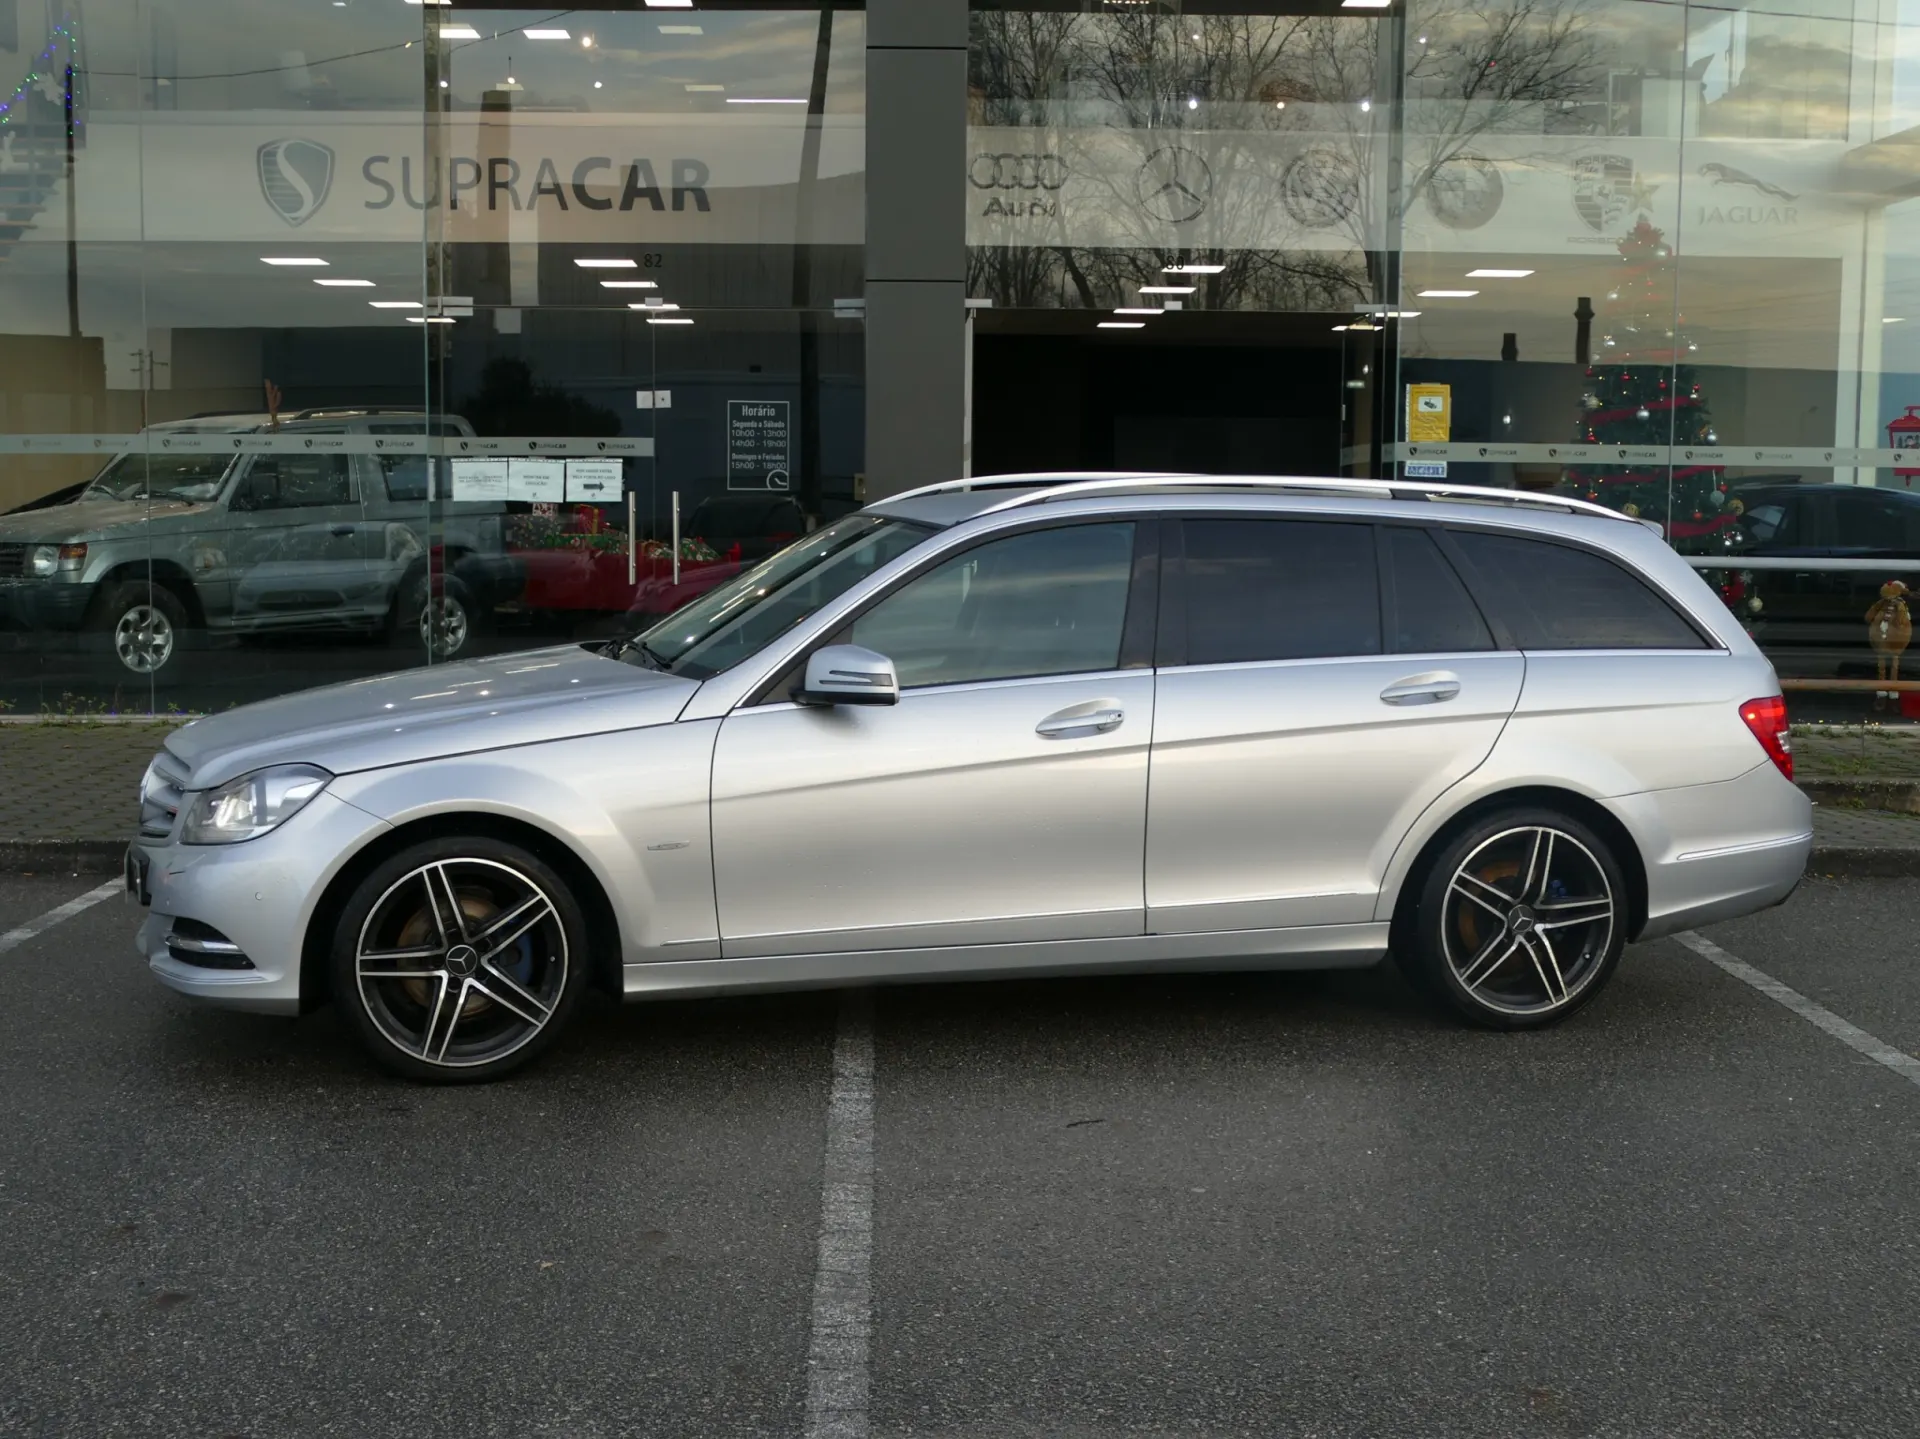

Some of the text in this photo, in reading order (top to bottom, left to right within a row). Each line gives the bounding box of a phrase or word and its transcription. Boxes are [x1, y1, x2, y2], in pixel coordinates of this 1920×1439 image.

[362, 155, 711, 212] SUPRACAR
[1699, 205, 1799, 226] JAGUAR
[643, 254, 663, 269] 82
[742, 405, 776, 416] Horário
